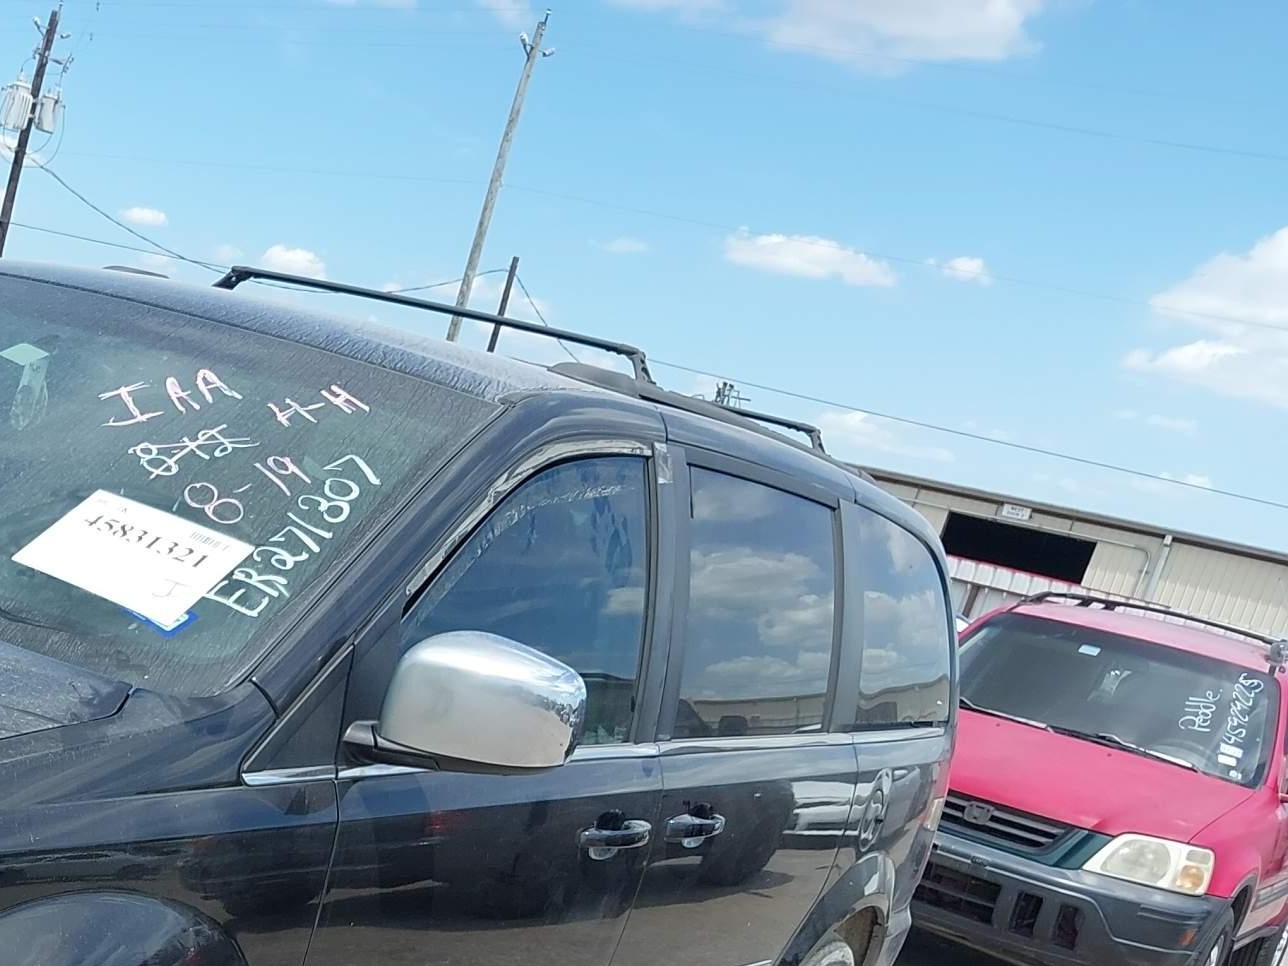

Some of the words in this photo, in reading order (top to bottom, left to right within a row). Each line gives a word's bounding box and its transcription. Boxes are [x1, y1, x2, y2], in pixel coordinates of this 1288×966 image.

[98, 369, 244, 427] IAA
[183, 456, 313, 524] 8-19
[84, 514, 210, 569] 45831321
